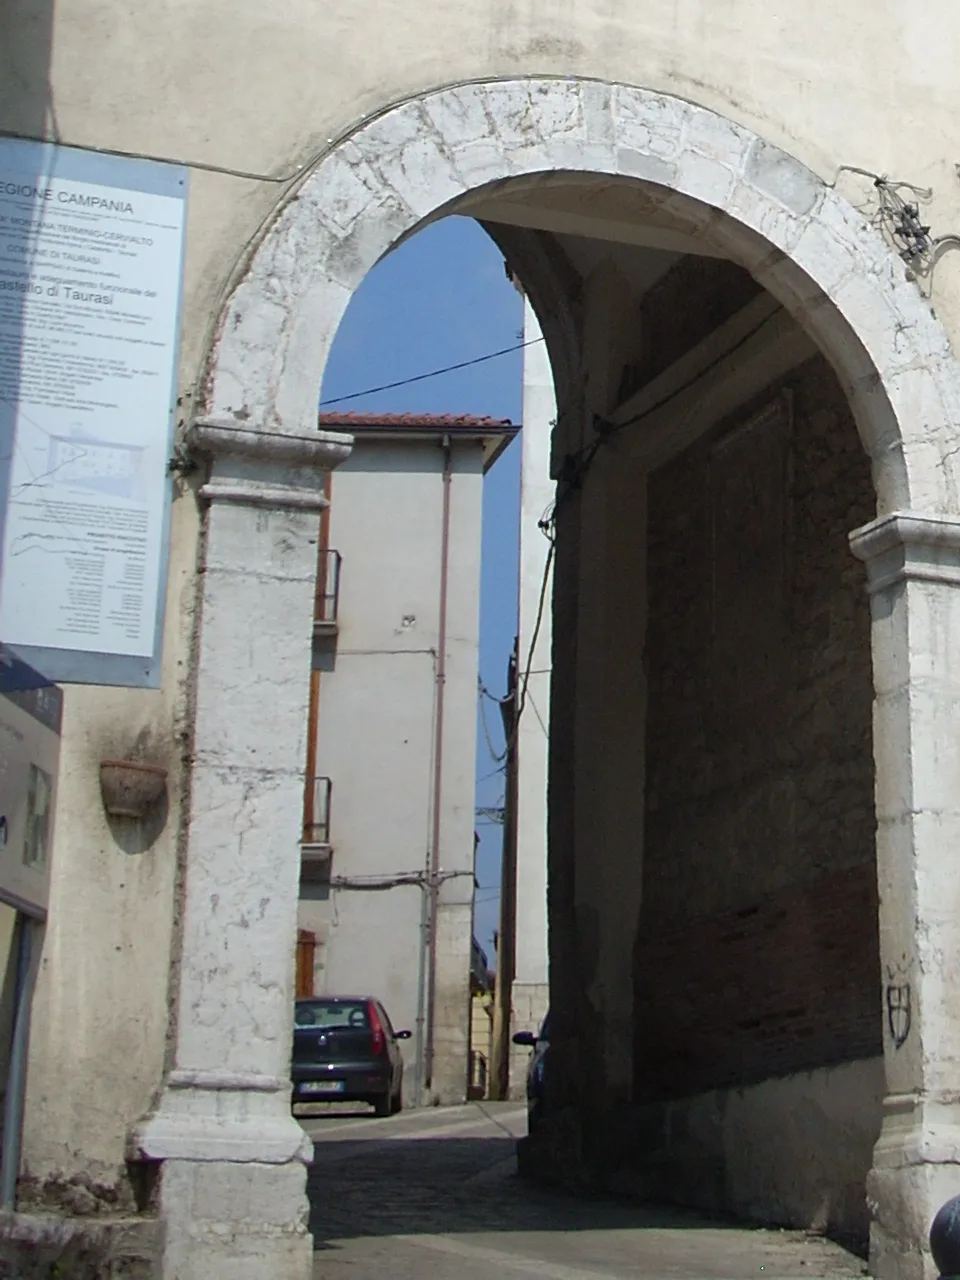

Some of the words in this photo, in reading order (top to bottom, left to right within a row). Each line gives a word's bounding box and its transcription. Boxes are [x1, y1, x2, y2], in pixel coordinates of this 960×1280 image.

[0, 181, 53, 201] EGIONE
[57, 191, 134, 215] CAMPANIA
[0, 280, 43, 296] astello
[47, 285, 59, 297] di
[63, 285, 114, 306] Taurasi
